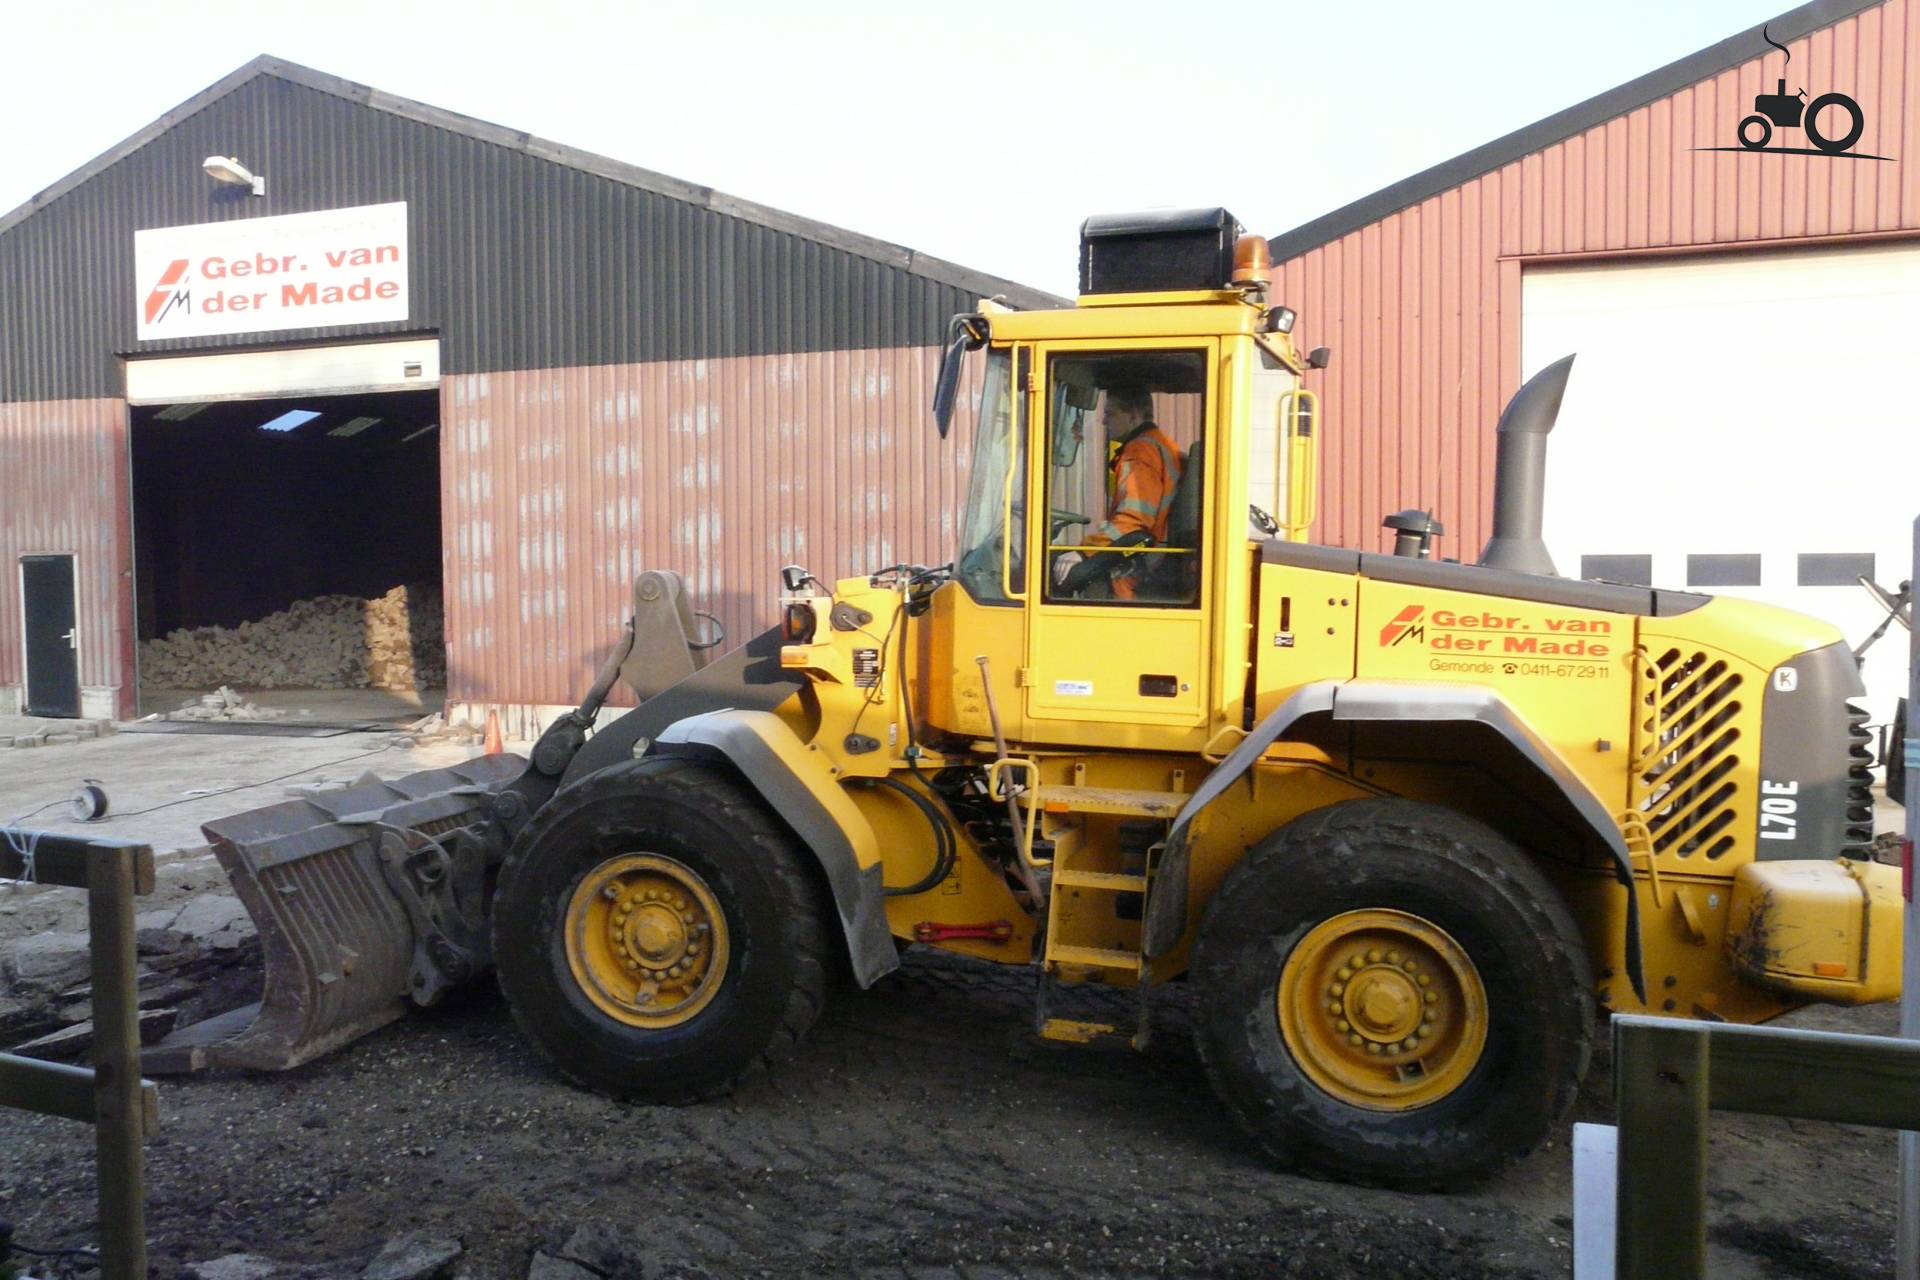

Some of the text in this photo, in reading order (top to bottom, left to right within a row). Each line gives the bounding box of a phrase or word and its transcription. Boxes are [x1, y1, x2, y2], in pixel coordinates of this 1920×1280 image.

[200, 245, 399, 279] Gebr. van
[202, 277, 399, 313] der Made
[1431, 610, 1611, 633] Gebr. van
[1430, 634, 1609, 656] der Made
[1429, 658, 1494, 673] Gemonde
